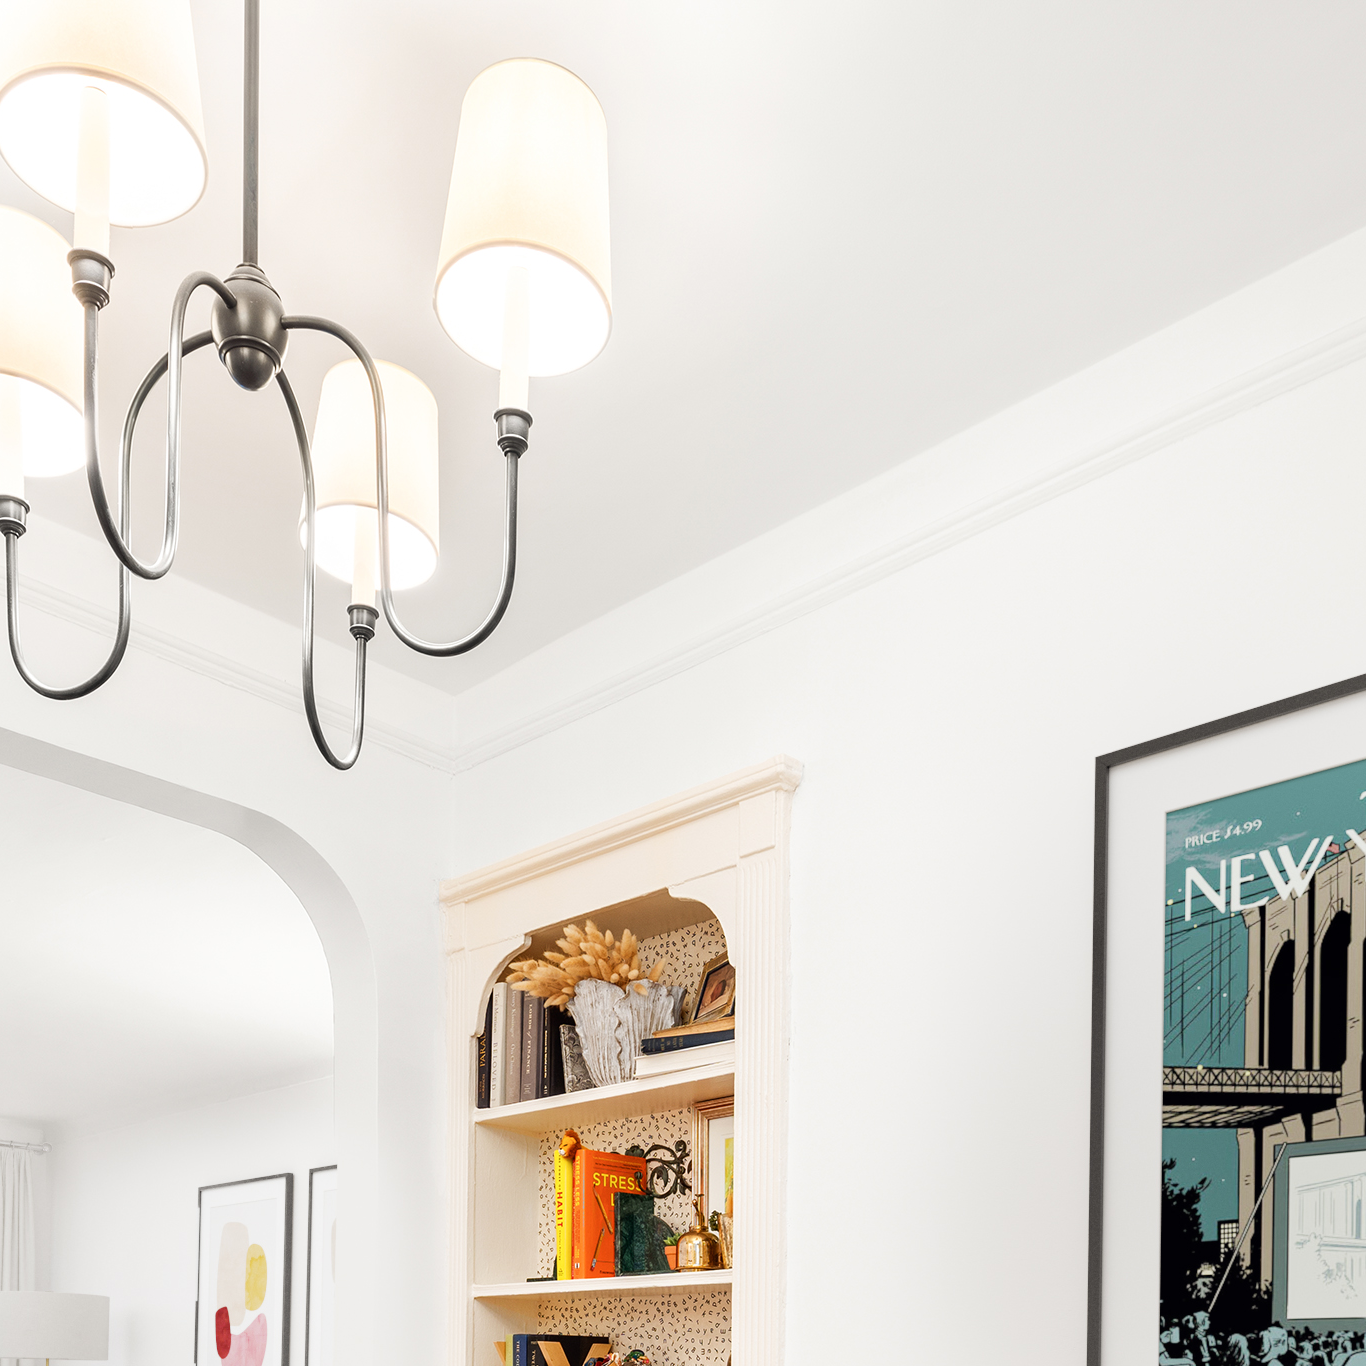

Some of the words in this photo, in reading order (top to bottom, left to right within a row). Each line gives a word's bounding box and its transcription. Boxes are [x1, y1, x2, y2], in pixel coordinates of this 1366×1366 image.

[1185, 830, 1221, 849] PRICE
[1224, 818, 1263, 840] $4.99
[1185, 835, 1334, 922] NEW
